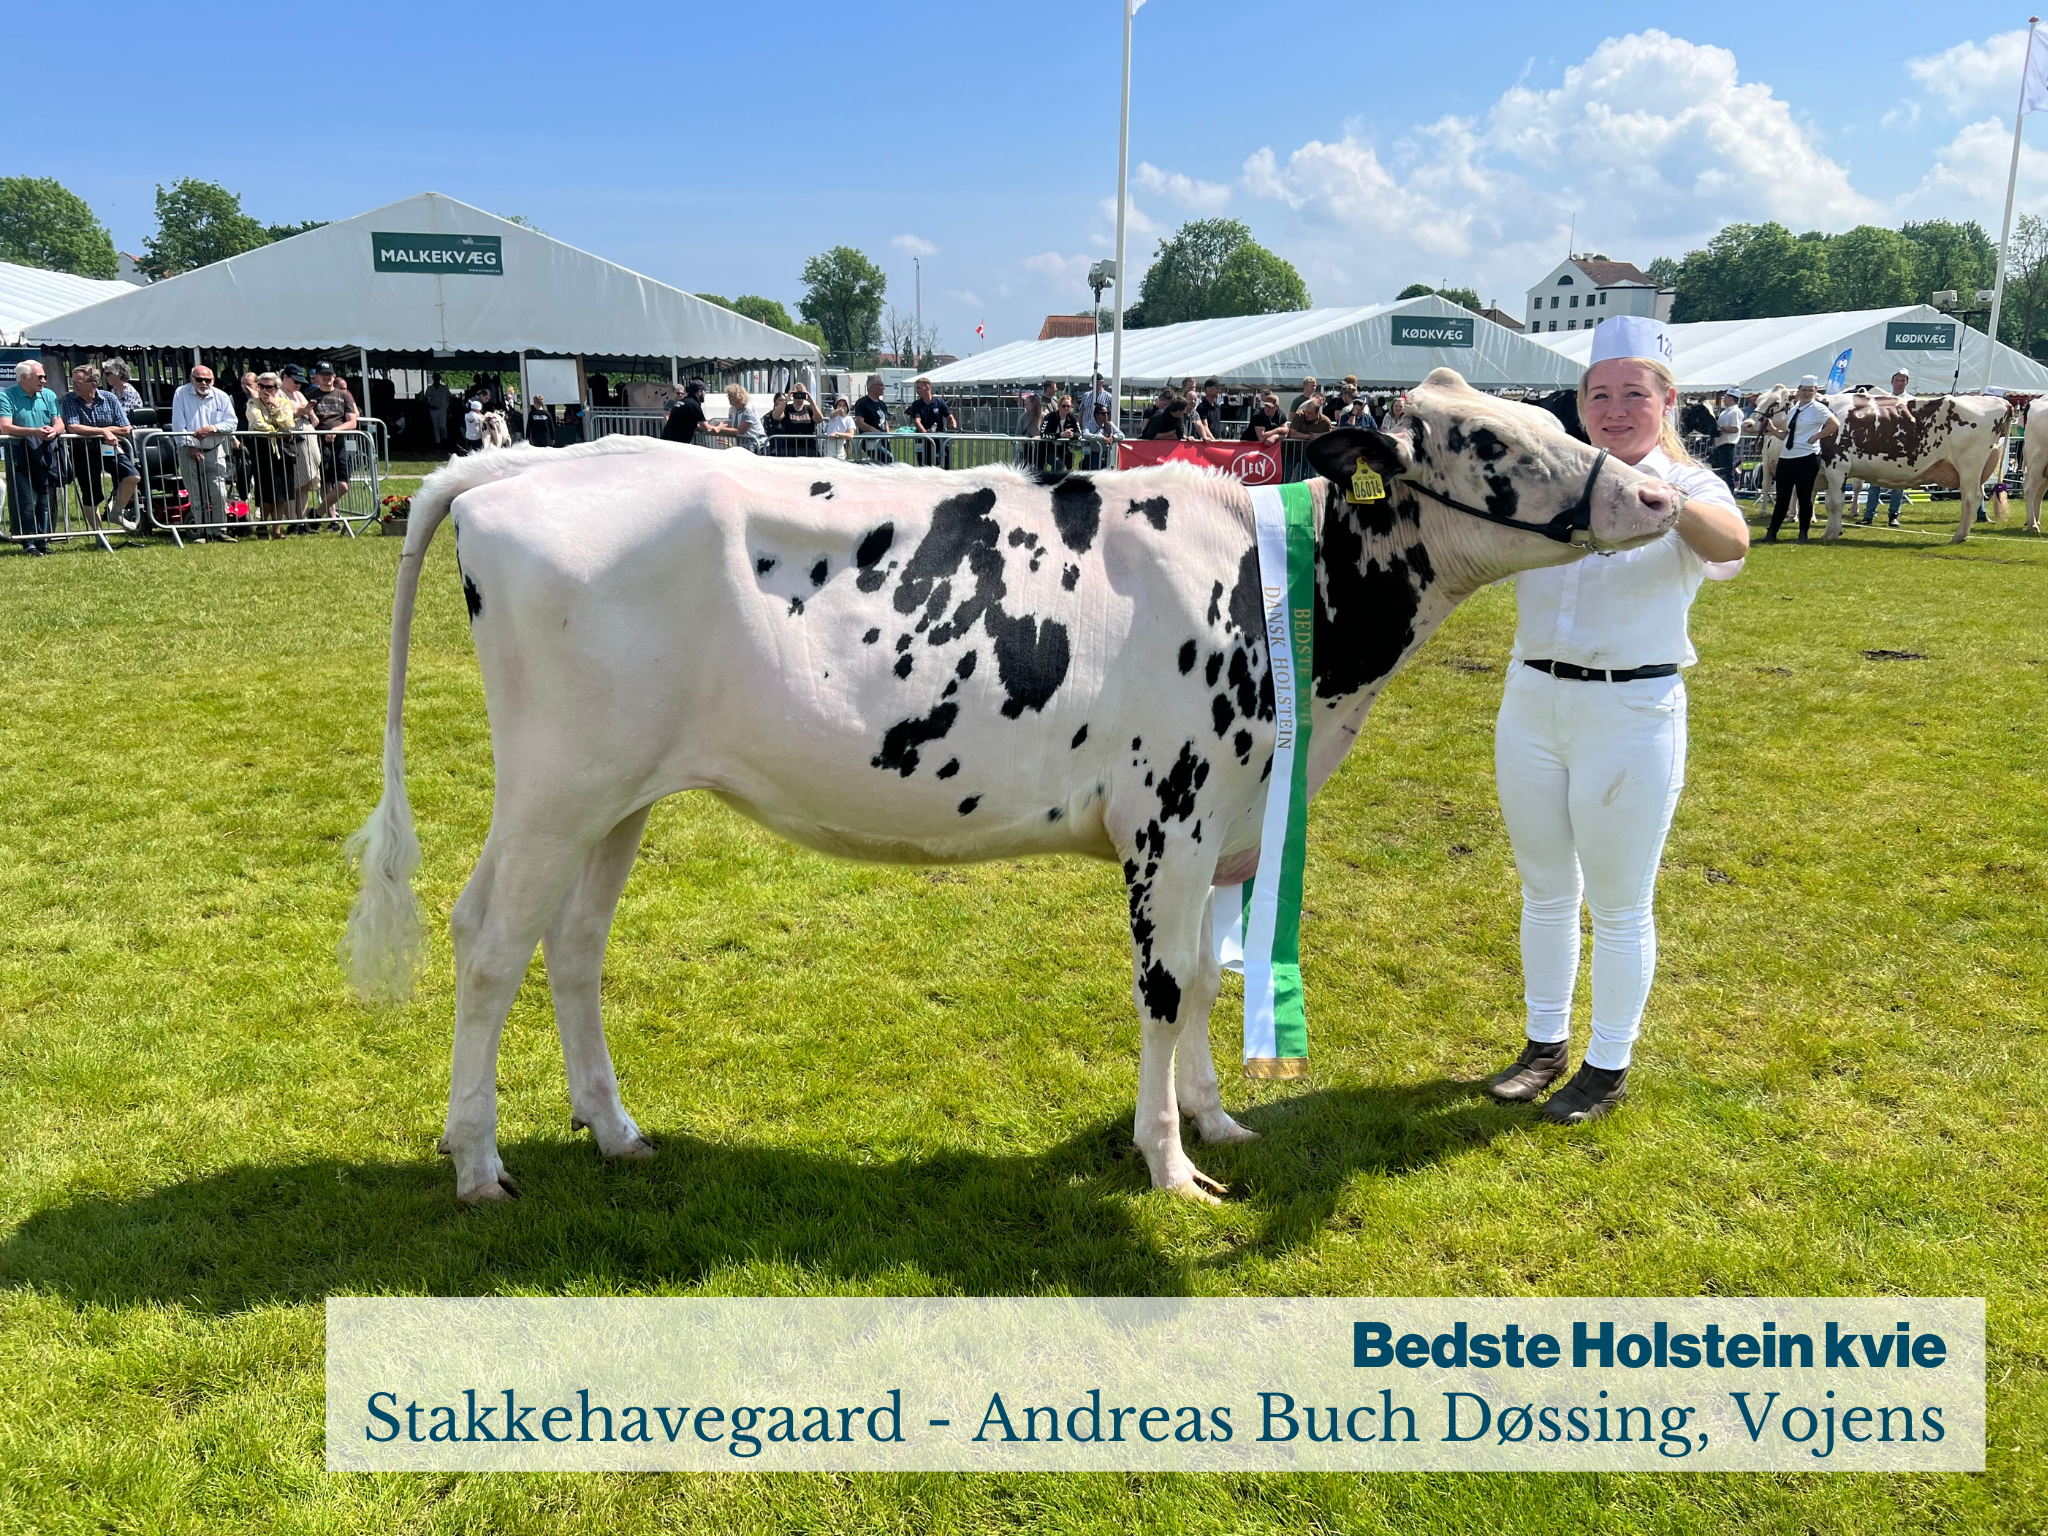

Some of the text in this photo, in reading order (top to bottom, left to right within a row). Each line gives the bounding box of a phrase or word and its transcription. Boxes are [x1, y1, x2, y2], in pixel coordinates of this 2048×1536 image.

[381, 248, 497, 265] MALKEKVÆG
[1402, 328, 1463, 341] KØDKVÆG
[1894, 333, 1946, 344] KØDKVÆG
[1241, 458, 1267, 480] LELY
[1354, 480, 1383, 499] 06014
[1293, 608, 1312, 677] BEDSTE
[1264, 586, 1293, 750] DANSK HOLSTEIN
